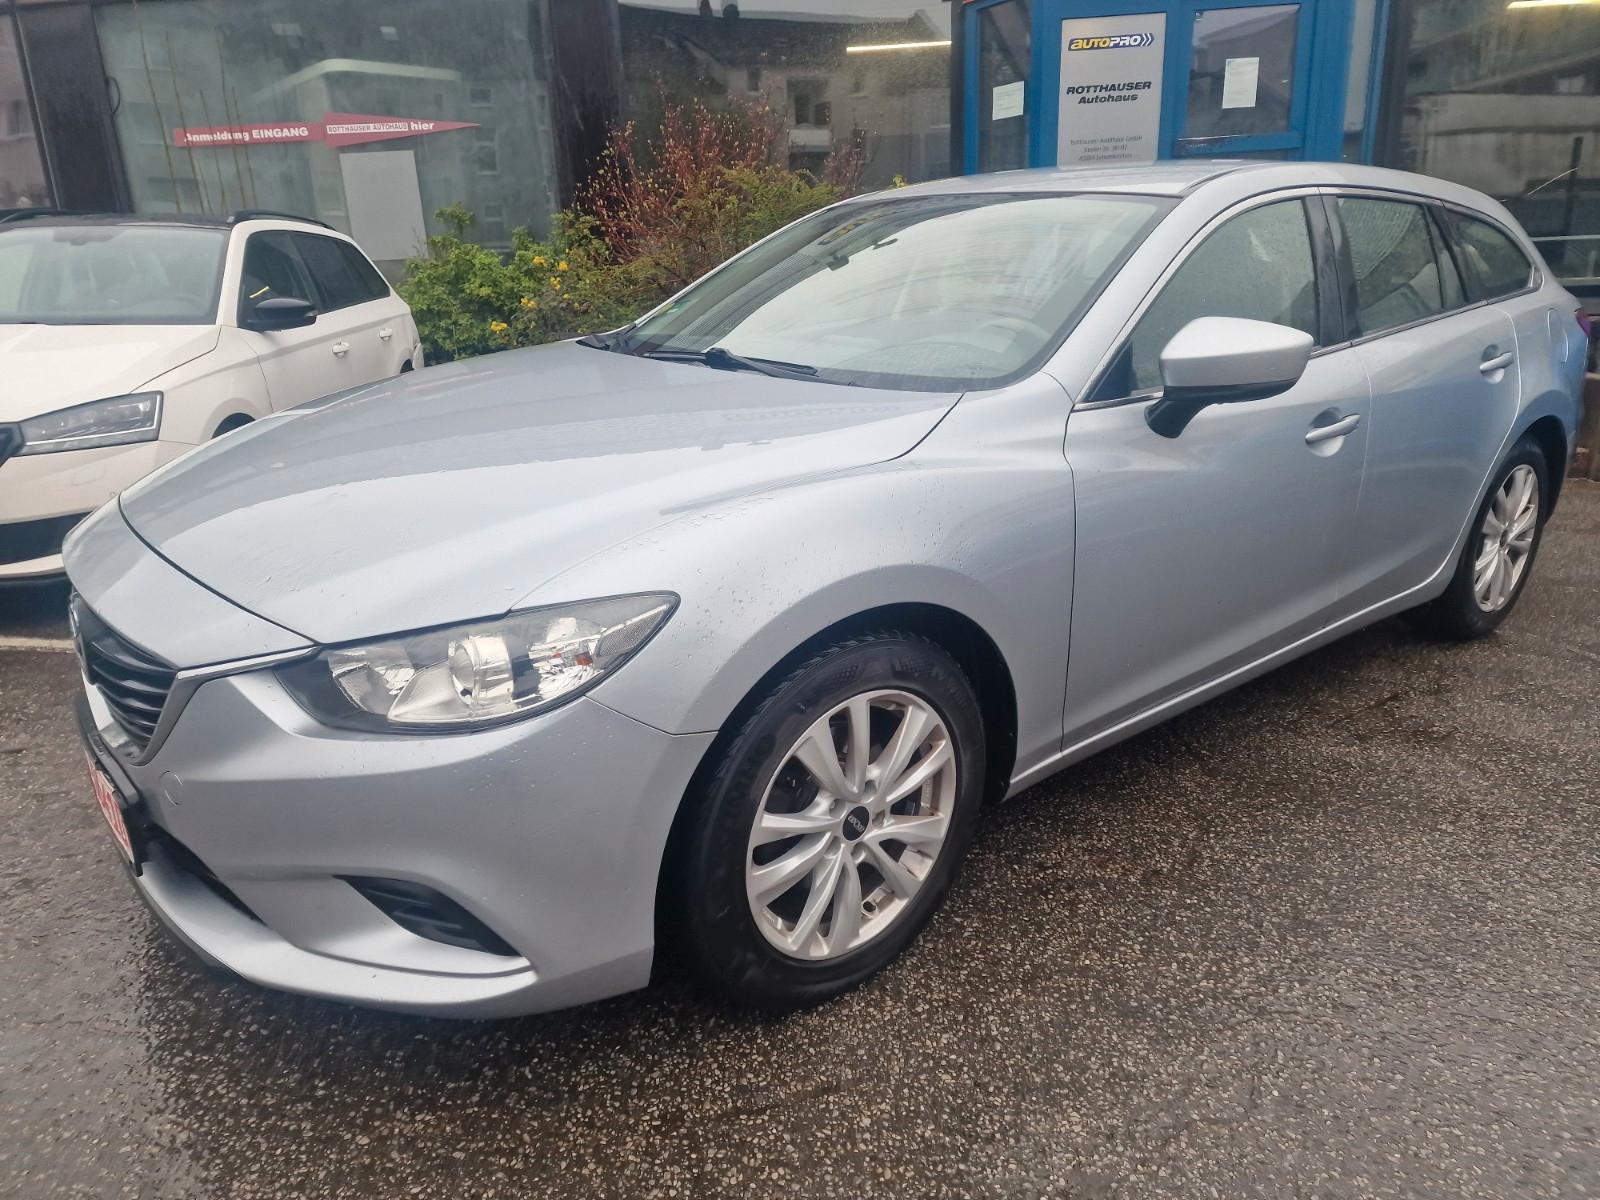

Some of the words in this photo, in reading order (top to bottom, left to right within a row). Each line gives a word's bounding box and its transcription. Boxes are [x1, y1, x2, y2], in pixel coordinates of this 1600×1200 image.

[1066, 81, 1152, 95] ROTTHAUSER
[1078, 94, 1138, 104] Autohaus
[252, 127, 309, 139] EINGANG
[372, 122, 407, 131] AUTOHAUS
[410, 121, 435, 131] hier
